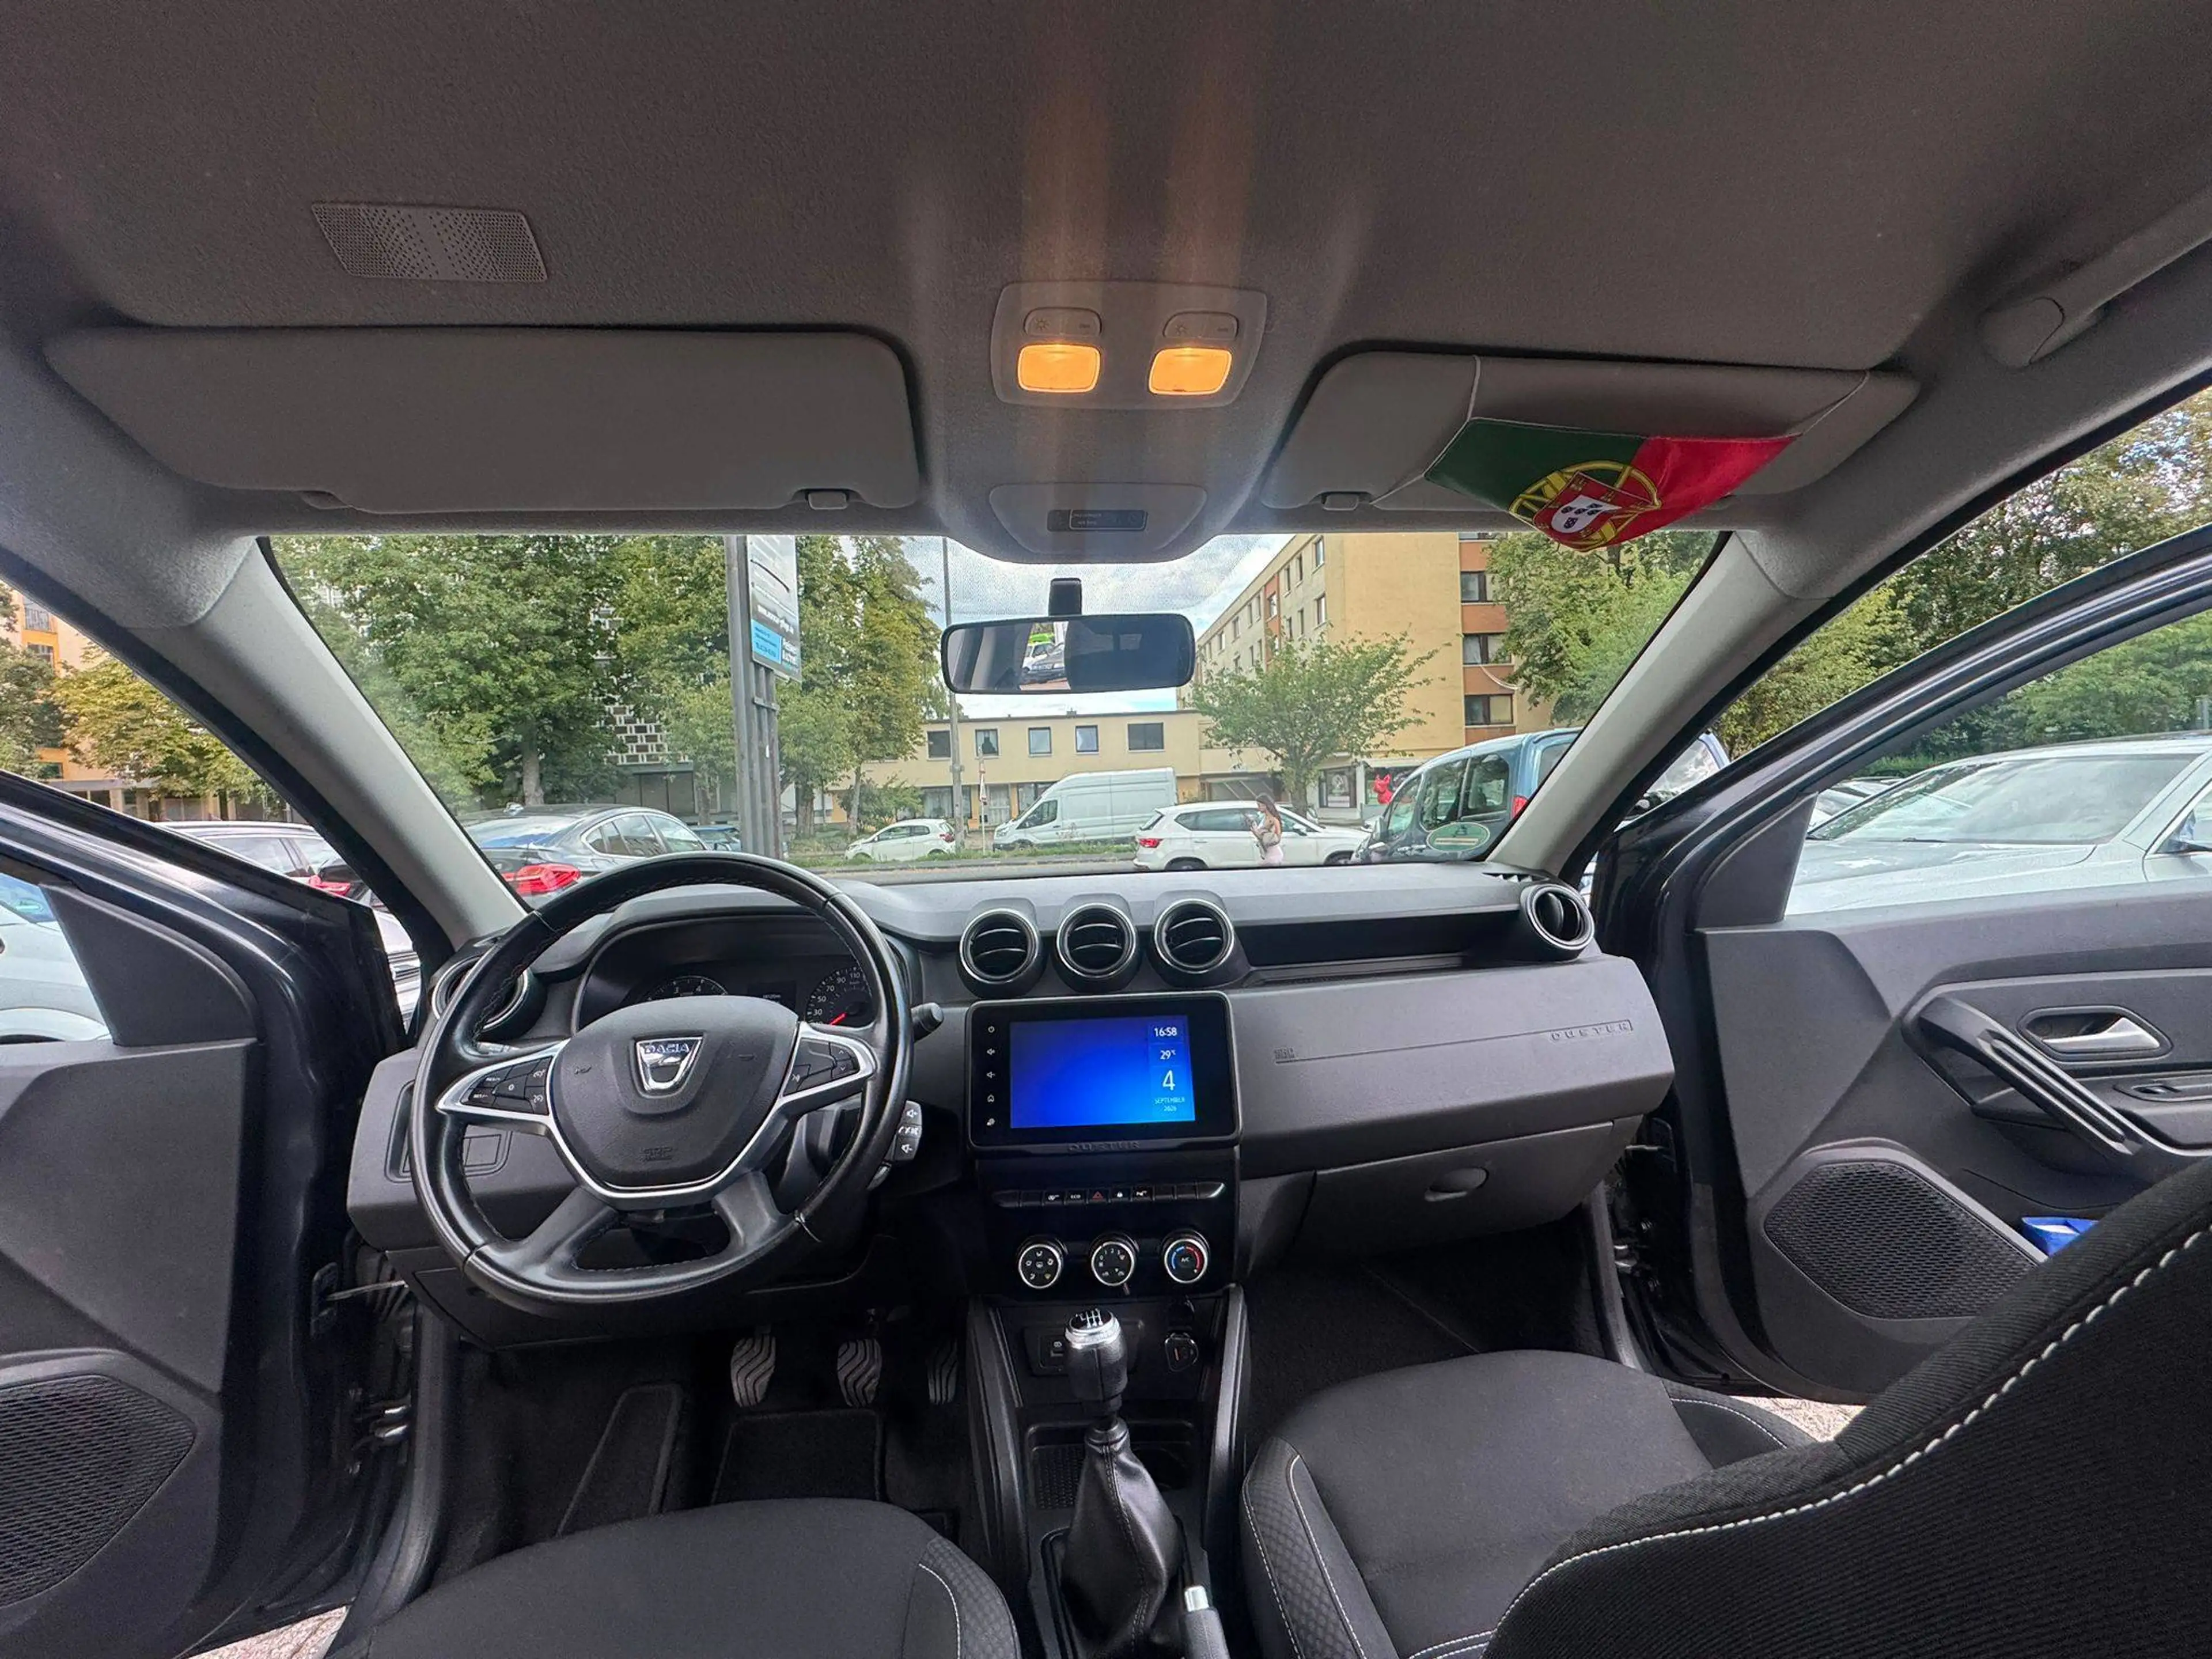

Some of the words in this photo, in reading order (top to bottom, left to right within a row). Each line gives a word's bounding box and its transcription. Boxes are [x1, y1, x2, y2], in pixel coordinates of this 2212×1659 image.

[1154, 1027, 1177, 1037] 16:58
[646, 1043, 690, 1053] DACIA
[1162, 1070, 1176, 1090] 4
[1154, 1096, 1185, 1105] SEPTEMBER
